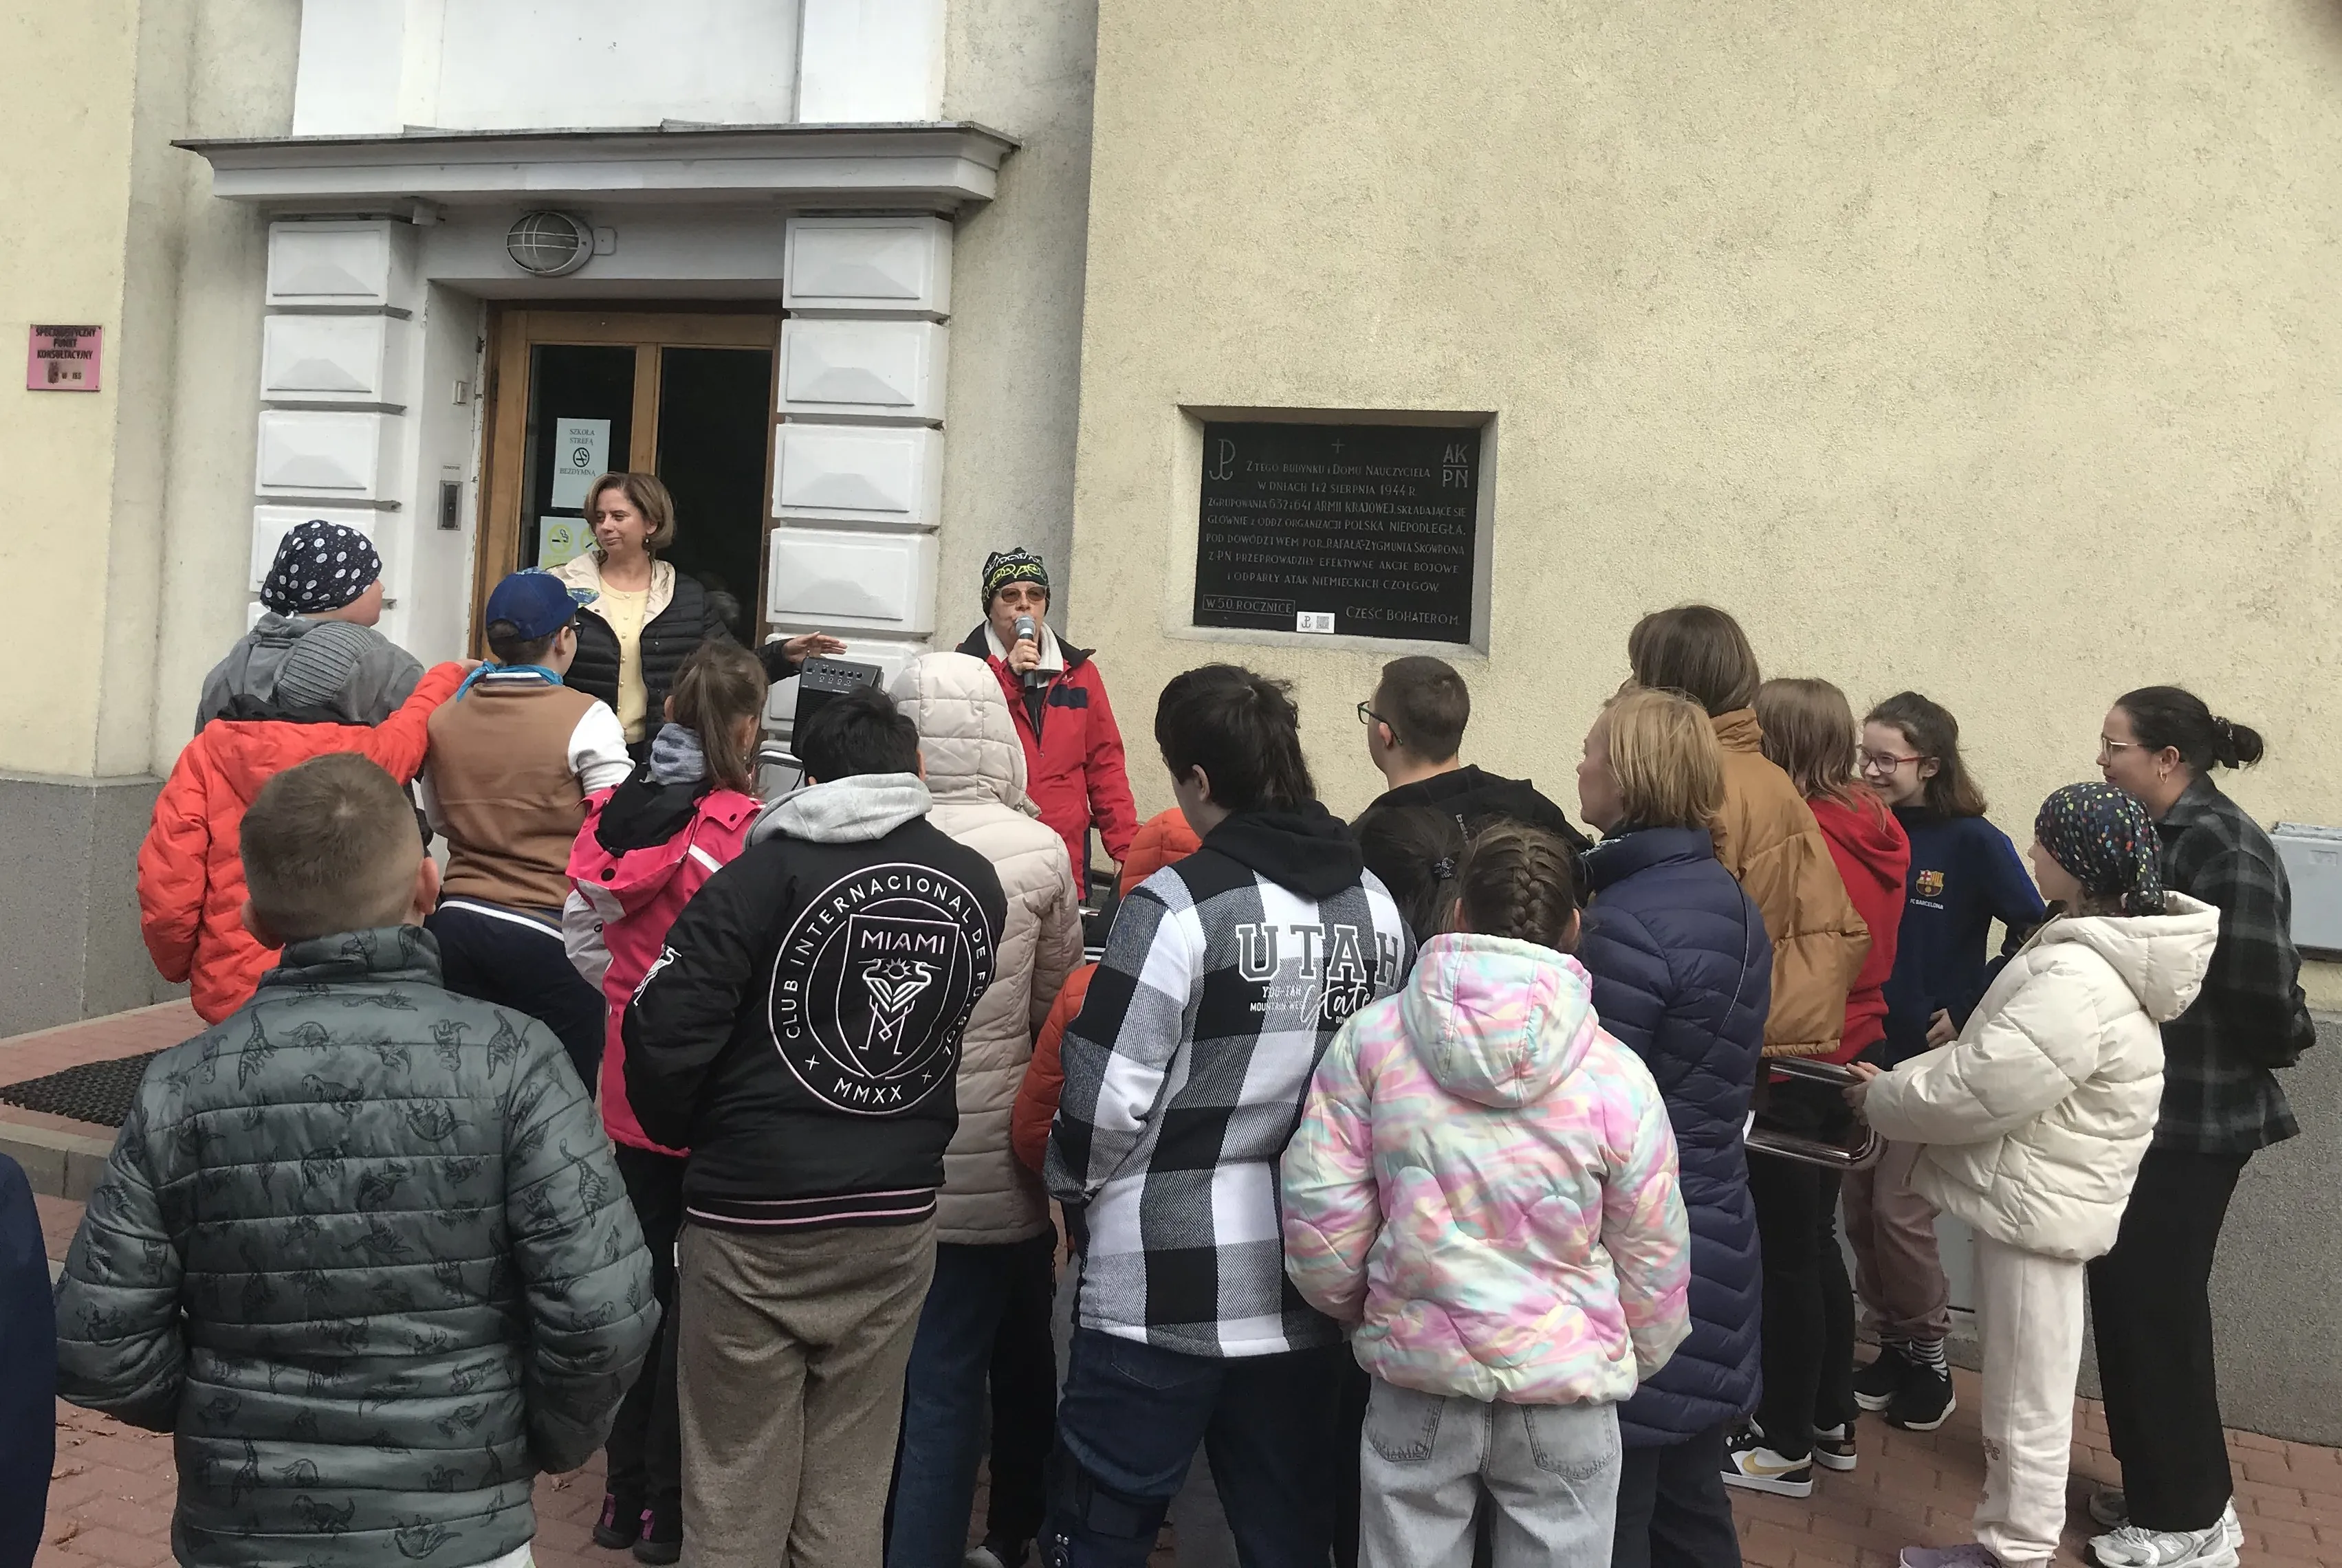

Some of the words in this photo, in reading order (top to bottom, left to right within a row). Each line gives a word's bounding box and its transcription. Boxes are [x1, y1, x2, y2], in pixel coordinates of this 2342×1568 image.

[35, 328, 96, 338] SPECJYCZNY
[37, 350, 94, 360] KONSULTACYJNY
[1443, 443, 1469, 463] AK
[1254, 463, 1279, 472] TEGO
[1283, 463, 1324, 474] BUDYNKU
[1333, 464, 1361, 475] DOMU
[1366, 465, 1431, 478] NAUCZYCIELA
[1442, 469, 1469, 488] PN
[1258, 481, 1266, 490] W
[1269, 482, 1307, 492] DNIACH
[1331, 484, 1375, 495] SIERPNIA
[1380, 485, 1406, 496] 1944
[1207, 497, 1267, 509] ZGRUPOWANIA
[1314, 500, 1342, 512] ARMII
[1397, 505, 1451, 517] SKŁADAJĄCE
[1285, 518, 1342, 529] ORGANIZACJI
[1344, 520, 1383, 531] POLSKA
[1206, 533, 1225, 543] POD
[1414, 542, 1465, 555] SKOWRONA
[1236, 553, 1315, 566] PRZEPROWADZIŁY
[1319, 557, 1375, 569] EFEKTYWNE
[1379, 561, 1409, 571] AKCJE
[1414, 562, 1460, 574] BOJOWE
[1234, 572, 1281, 583] ODPARŁY
[1284, 575, 1309, 584] ATAK
[1312, 576, 1379, 589] NIEMIECKICH
[1206, 599, 1216, 608] W
[1346, 605, 1383, 619] CZEŚĆ
[1916, 899, 1943, 909] BARCELONA
[790, 874, 976, 966] INTERNACIONAL
[861, 929, 945, 955] MIAMI
[972, 928, 986, 960] DE
[1235, 921, 1400, 991] UTAH
[781, 980, 800, 1039] CLUB
[942, 971, 986, 1056] FBOL
[1250, 1001, 1286, 1013] MOUNTAIN
[1289, 1000, 1307, 1010] WES
[833, 1077, 902, 1104] MMXX
